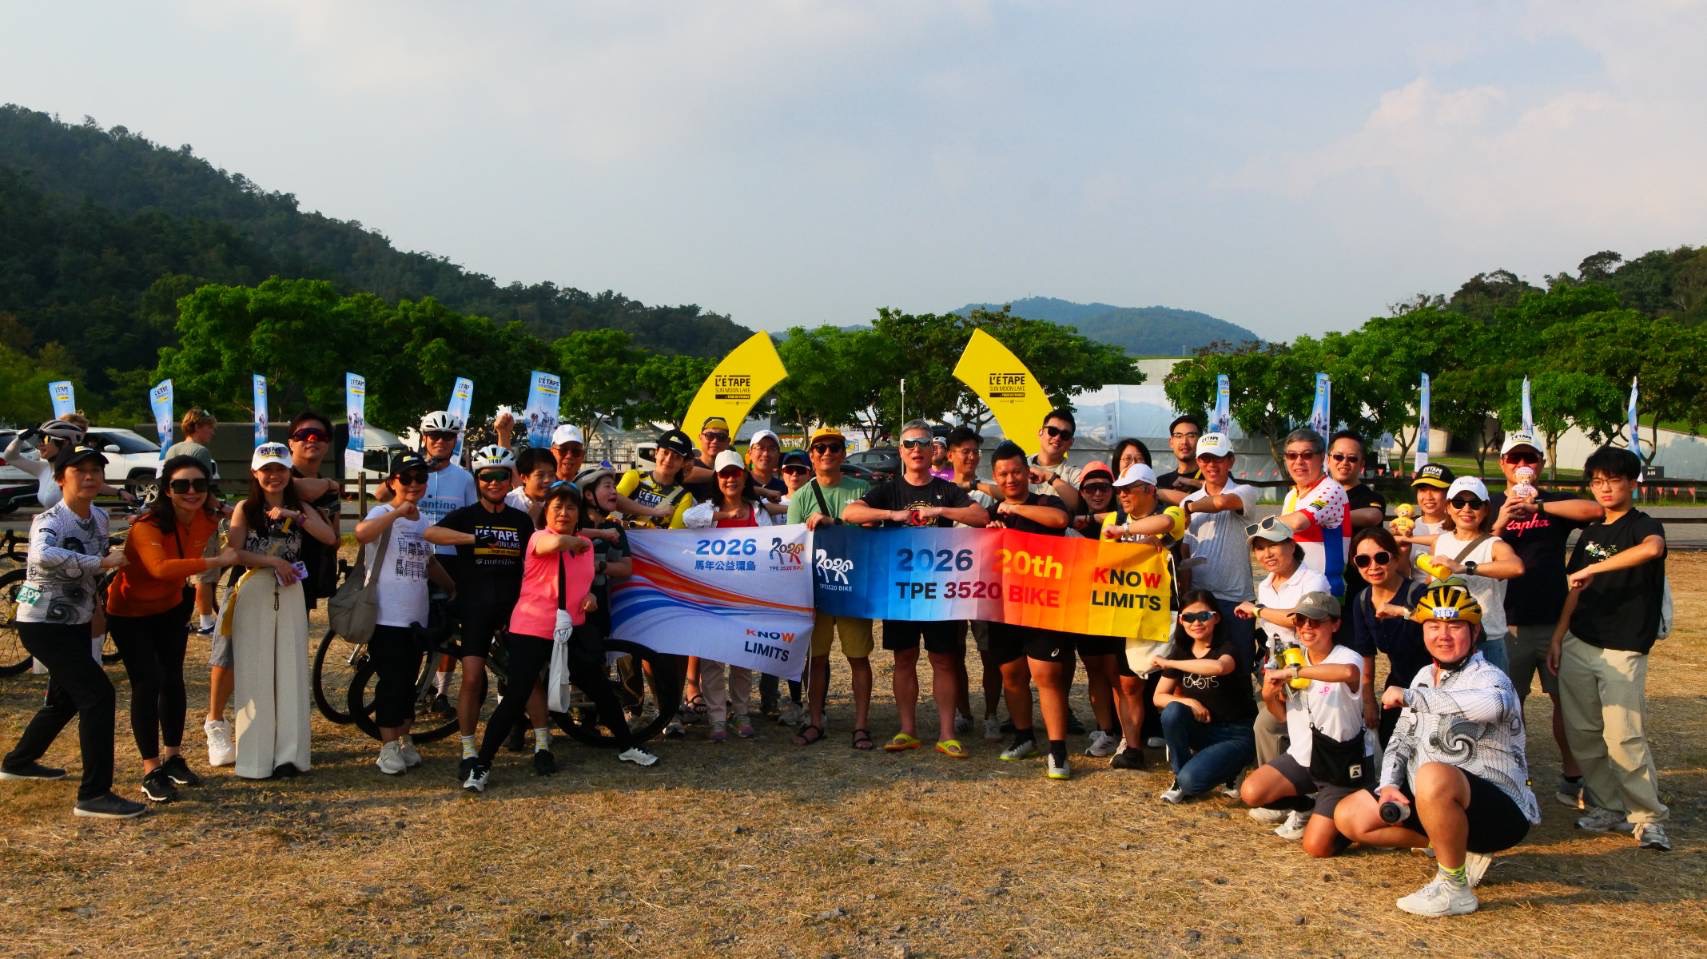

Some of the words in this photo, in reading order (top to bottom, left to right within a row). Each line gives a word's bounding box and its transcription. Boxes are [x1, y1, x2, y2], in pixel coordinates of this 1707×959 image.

[696, 538, 757, 556] 2026
[896, 548, 974, 572] 2026
[992, 548, 1064, 579] 20th
[1093, 567, 1162, 589] KNOW
[895, 581, 938, 599] TPE
[943, 581, 1003, 599] 3520
[1008, 584, 1060, 608] BIKE
[1091, 590, 1162, 612] LIMITS
[746, 628, 795, 643] KNOW
[744, 640, 790, 662] LIMITS
